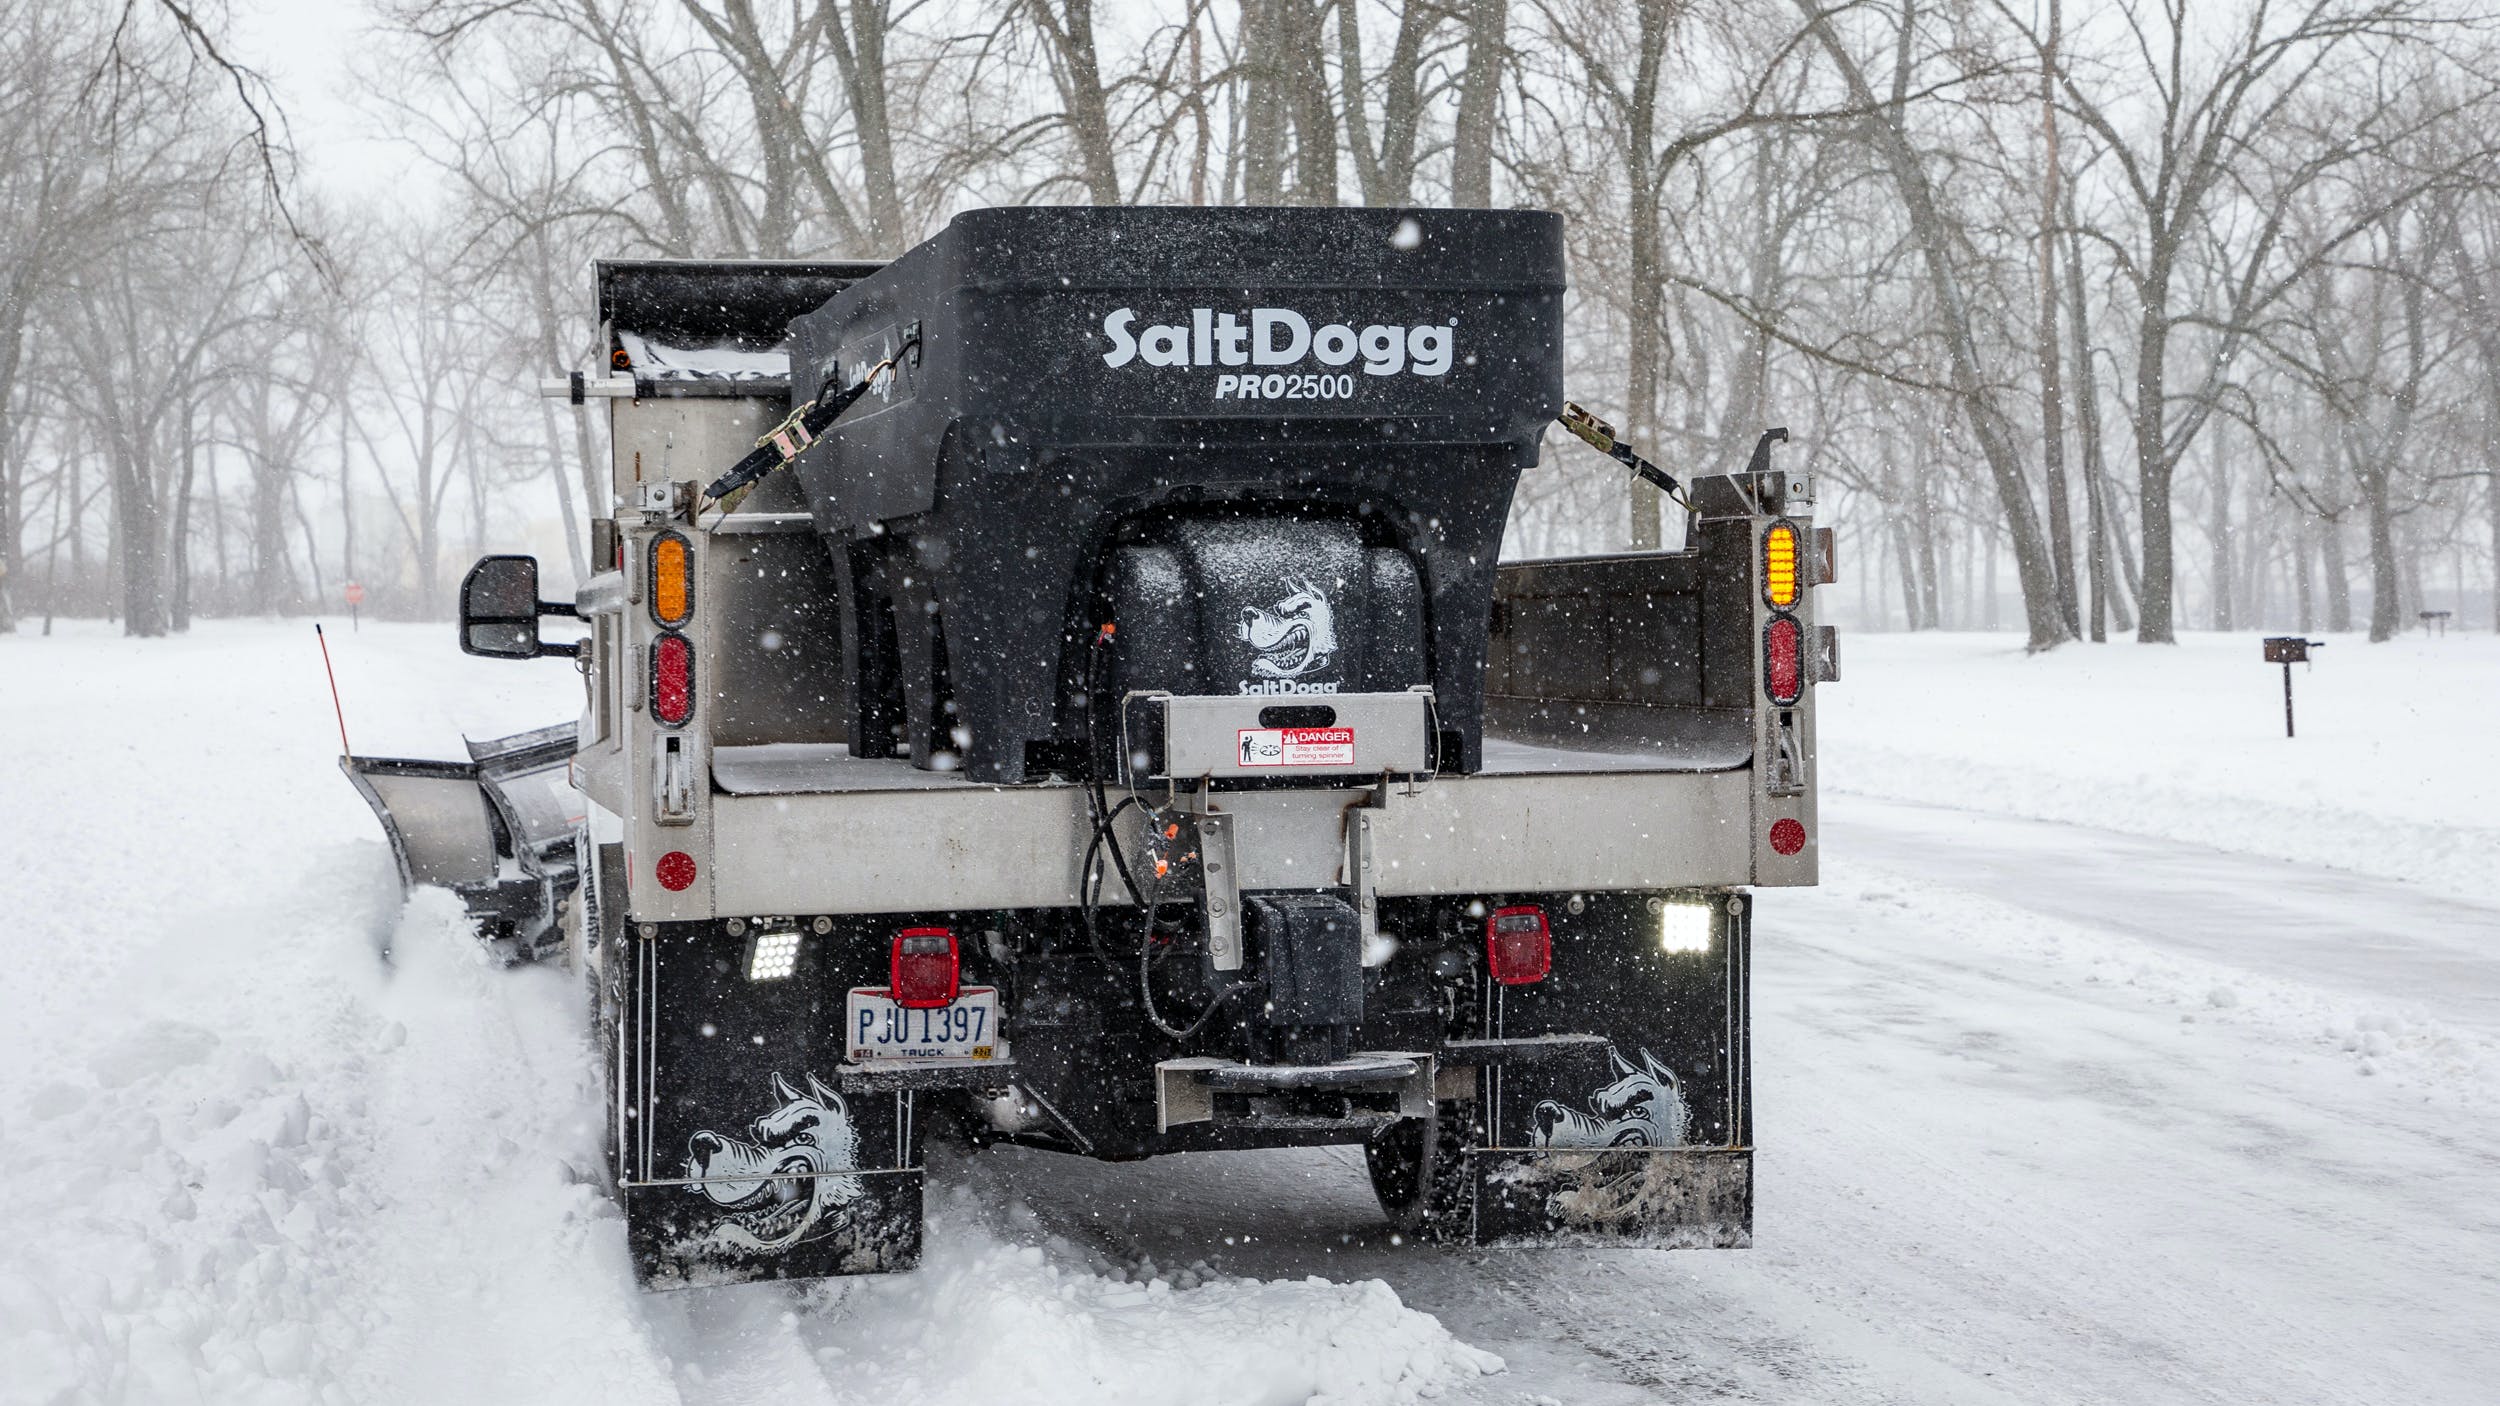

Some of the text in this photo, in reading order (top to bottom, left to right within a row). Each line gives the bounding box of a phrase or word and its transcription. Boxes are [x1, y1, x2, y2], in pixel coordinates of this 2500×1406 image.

[1215, 374, 1354, 400] PRO2500
[1299, 732, 1350, 742] DANGER
[859, 1006, 986, 1045] PJU 1397
[901, 1048, 945, 1057] TRUCK
